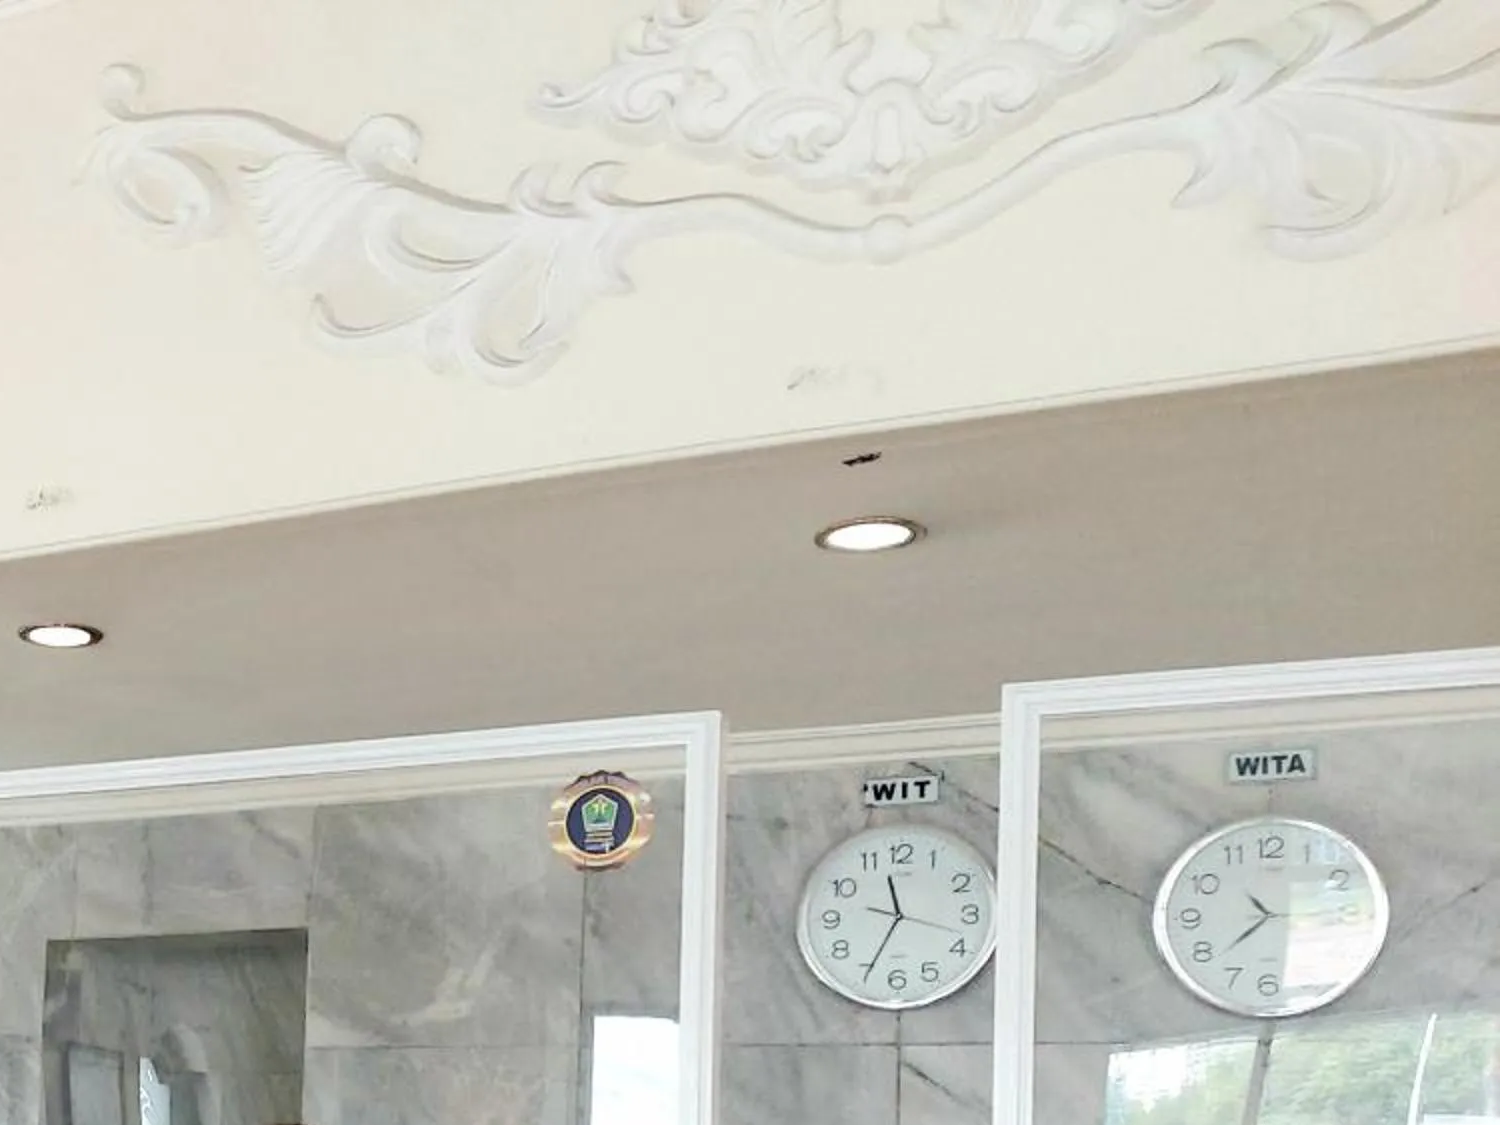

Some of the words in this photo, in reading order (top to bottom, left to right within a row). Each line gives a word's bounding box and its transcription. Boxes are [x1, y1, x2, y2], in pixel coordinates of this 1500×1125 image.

[1235, 754, 1307, 776] WITA
[873, 780, 931, 801] WIT
[890, 844, 914, 865] 12
[1224, 845, 1243, 864] 11
[1258, 836, 1285, 859] 12
[1304, 844, 1311, 863] 1
[861, 852, 878, 871] 11
[929, 850, 937, 868] 1
[832, 878, 857, 898] 10
[951, 873, 971, 893] 2
[1191, 873, 1220, 895] 10
[1328, 869, 1349, 891] 2
[821, 910, 841, 929] 9
[961, 904, 979, 924] 3
[1180, 908, 1201, 930] 9
[831, 939, 850, 959] 8
[949, 938, 966, 957] 4
[1192, 941, 1213, 963] 8
[888, 970, 907, 990] 6
[921, 962, 939, 982] 5
[1224, 967, 1243, 989] 7
[1257, 974, 1279, 996] 6
